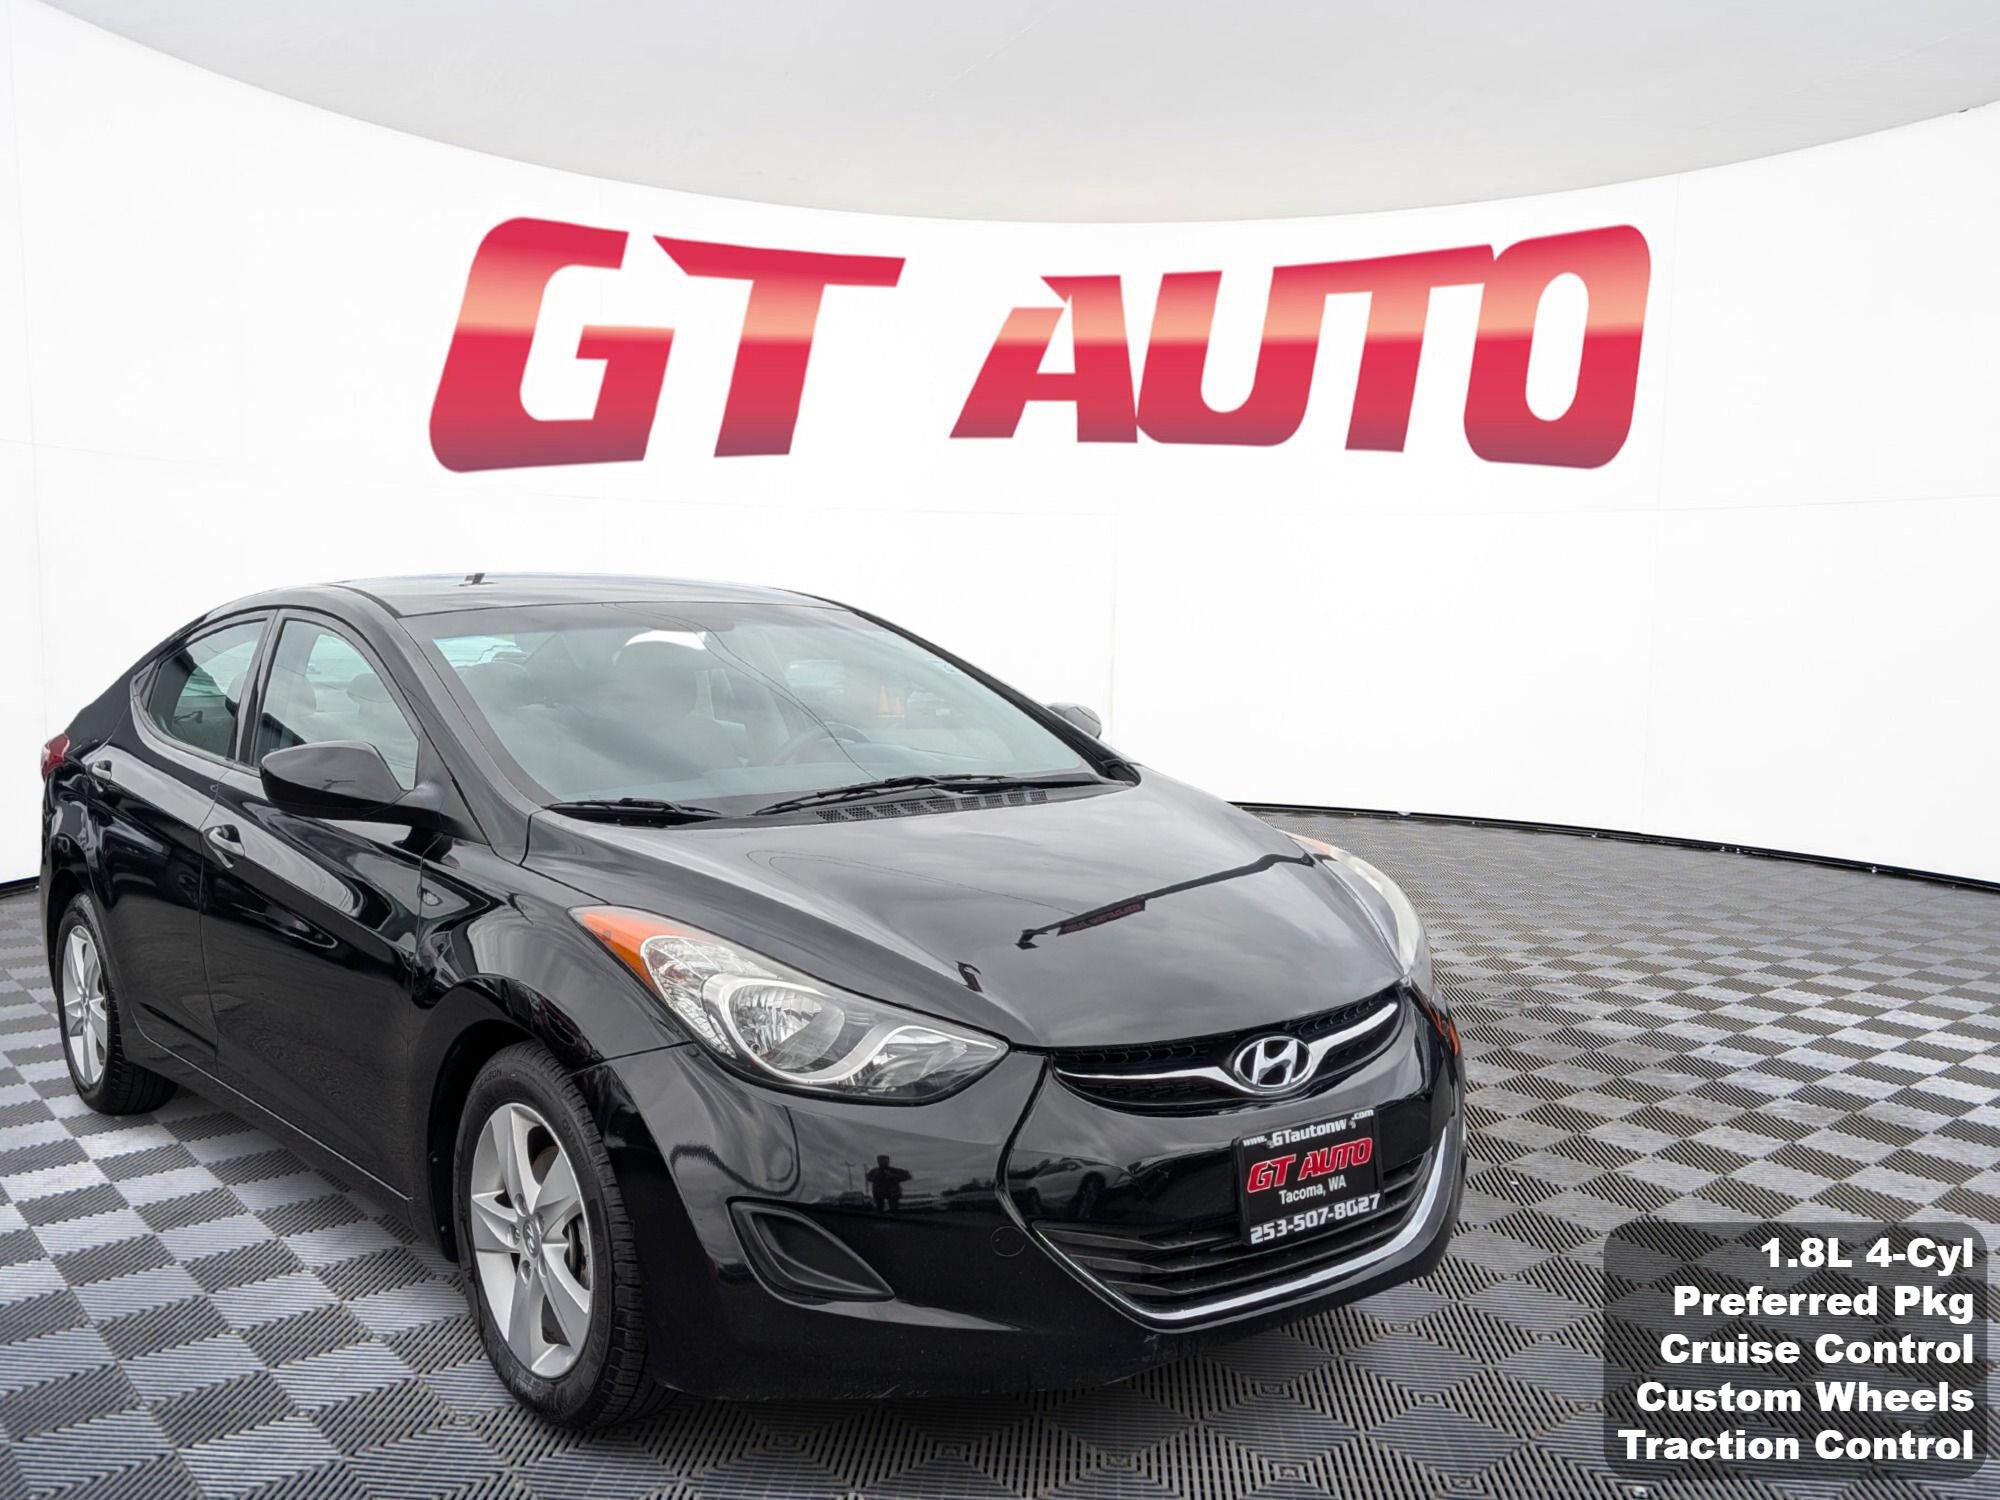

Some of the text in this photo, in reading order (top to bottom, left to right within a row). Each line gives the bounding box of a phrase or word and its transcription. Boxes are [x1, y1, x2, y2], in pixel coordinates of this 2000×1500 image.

[429, 217, 1652, 473] GT AUTO
[1246, 1137, 1373, 1193] GT AUTO
[1278, 1174, 1347, 1205] Tacoma, WA
[1250, 1192, 1381, 1245] 253-507-8027
